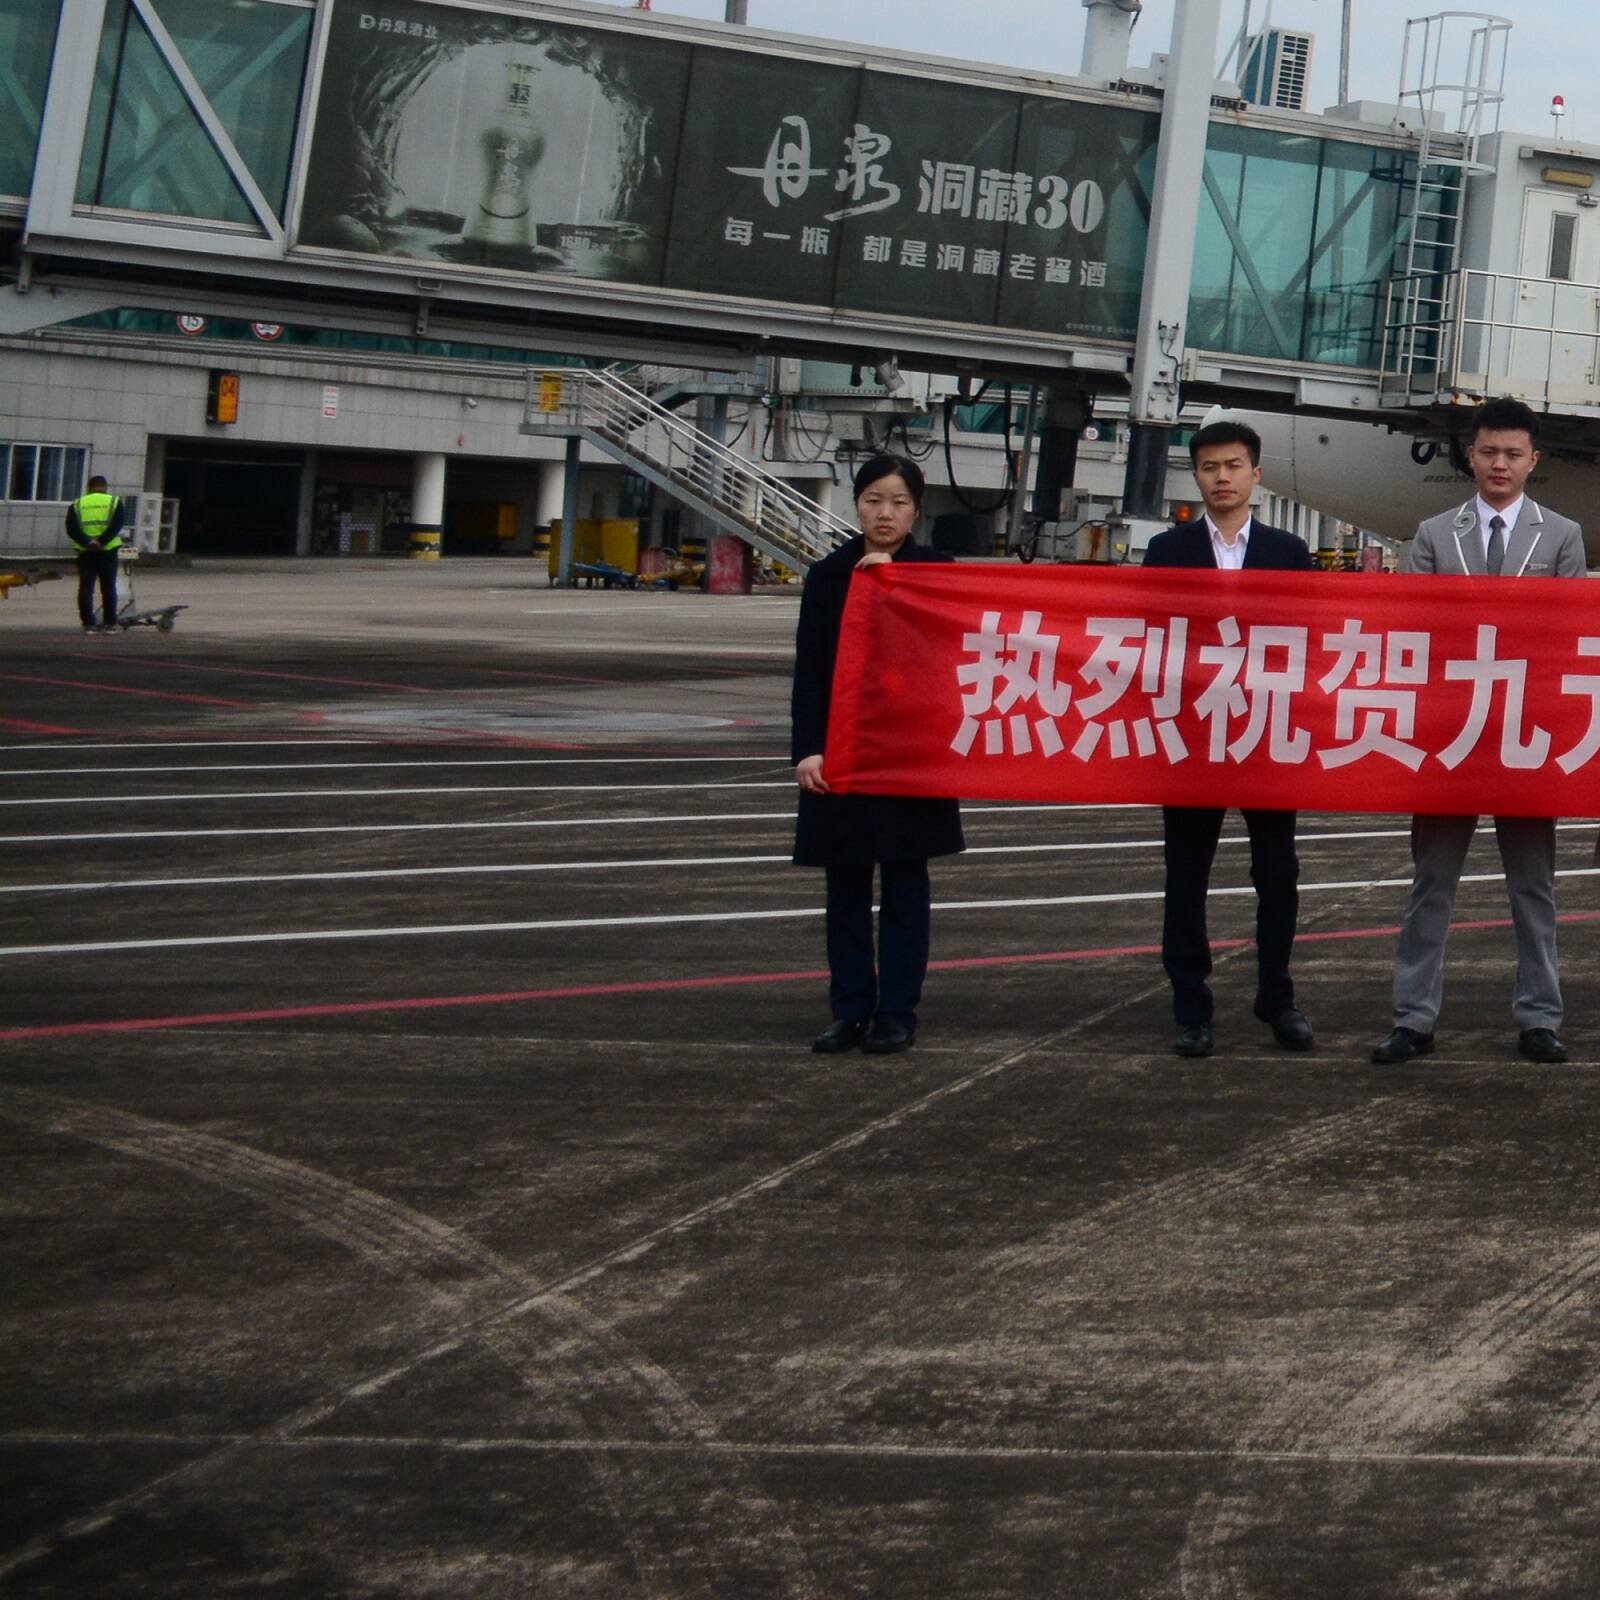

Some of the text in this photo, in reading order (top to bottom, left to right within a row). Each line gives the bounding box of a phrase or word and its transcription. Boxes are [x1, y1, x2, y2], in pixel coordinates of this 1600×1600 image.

[726, 115, 1105, 234] 丹泉 洞藏30
[724, 217, 1108, 288] 每一瓶 都是洞藏老酱酒
